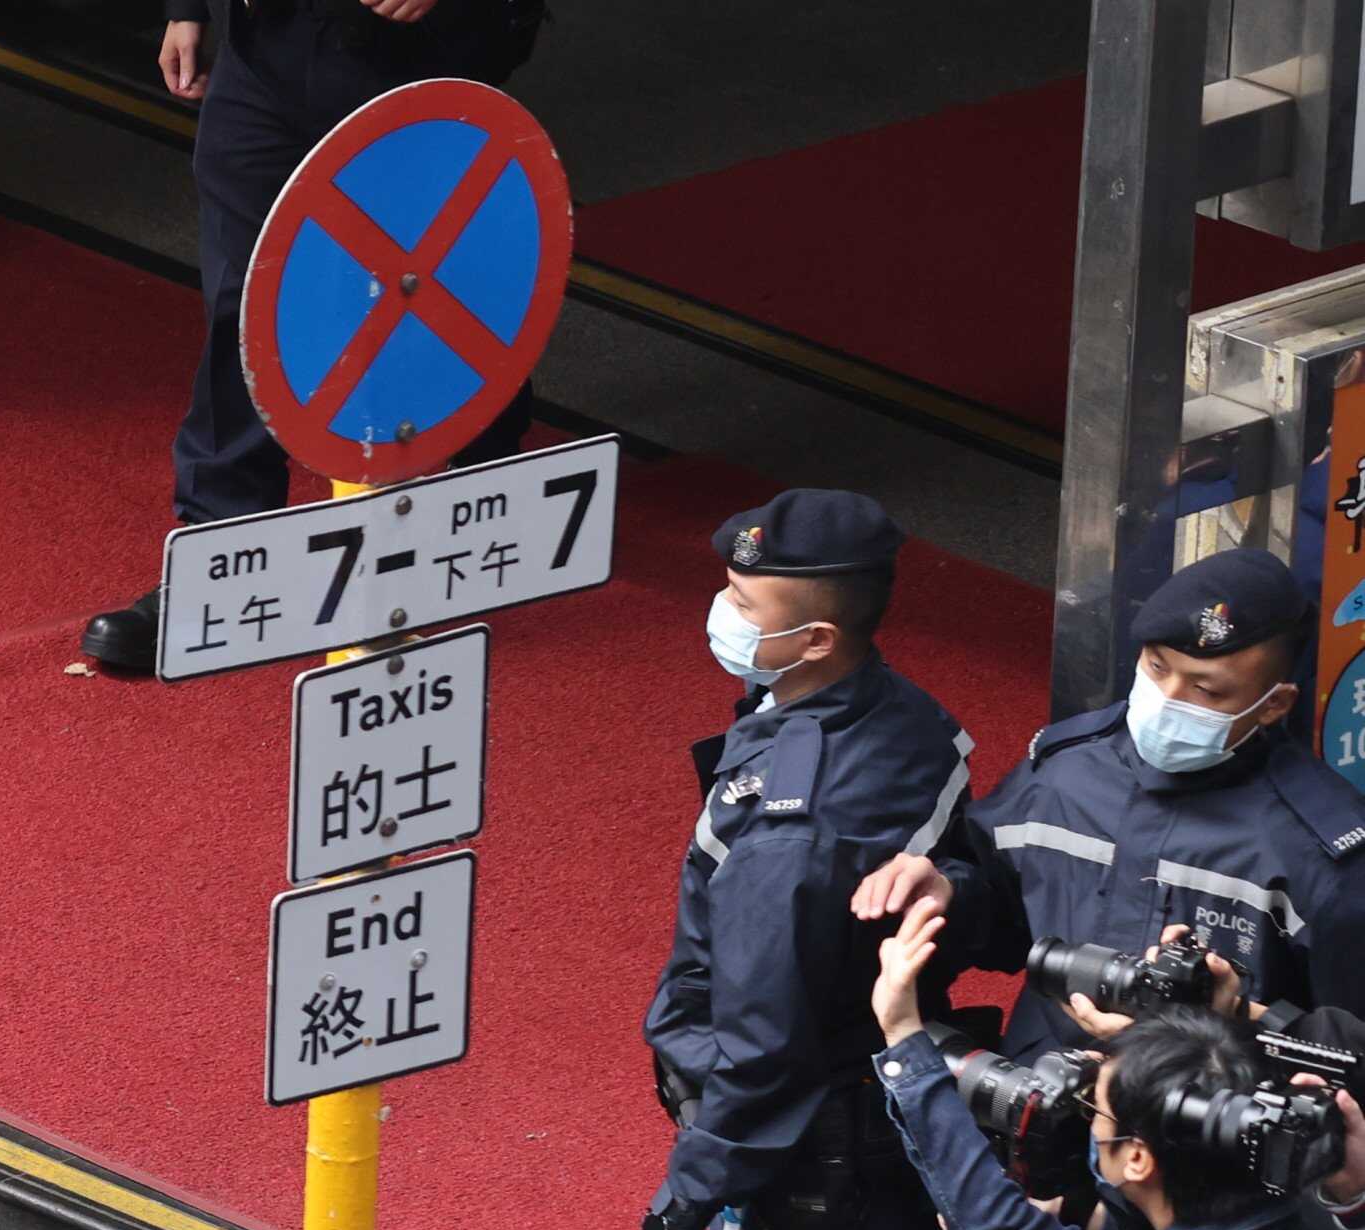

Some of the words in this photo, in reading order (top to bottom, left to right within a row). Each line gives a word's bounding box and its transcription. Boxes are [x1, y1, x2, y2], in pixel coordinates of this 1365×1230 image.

[208, 546, 267, 580] am
[452, 493, 507, 535] pm
[543, 469, 598, 570] 7
[185, 595, 281, 653] 上午
[433, 541, 519, 599] 下午
[331, 669, 454, 737] Taxis
[321, 745, 457, 847] 的士
[326, 891, 423, 958] End
[1195, 905, 1257, 937] POLICE
[298, 969, 440, 1065] 終止
